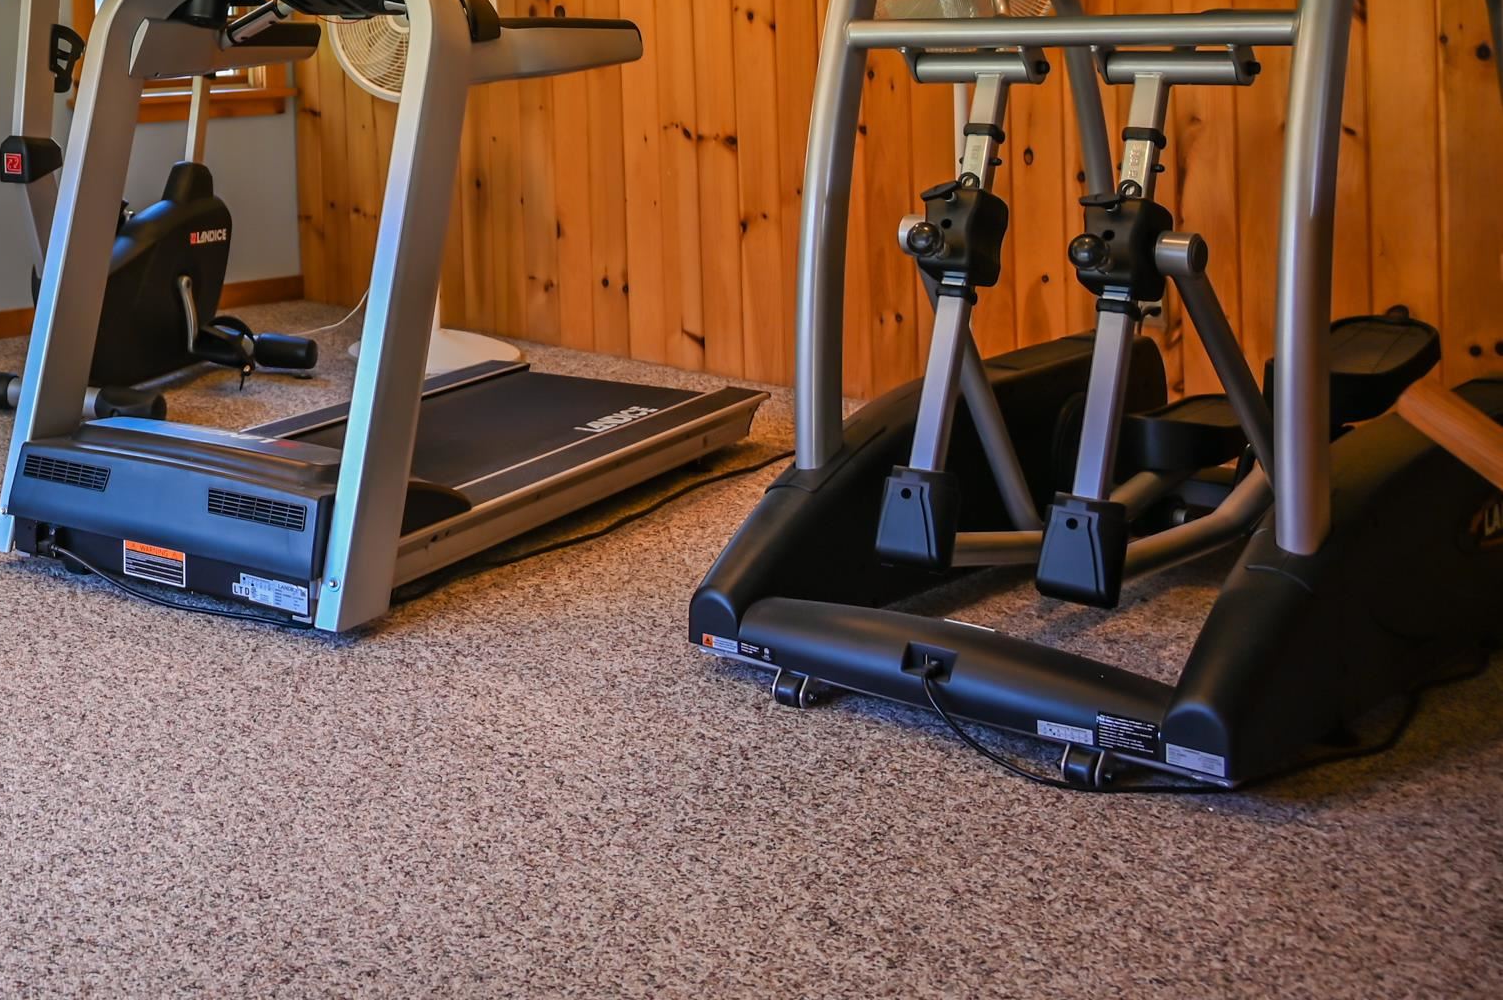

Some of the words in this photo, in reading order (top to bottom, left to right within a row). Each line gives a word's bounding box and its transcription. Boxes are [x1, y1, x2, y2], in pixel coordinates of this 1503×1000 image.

[196, 228, 227, 244] LANDICE
[573, 405, 659, 433] LANDICE
[233, 584, 250, 596] LTD
